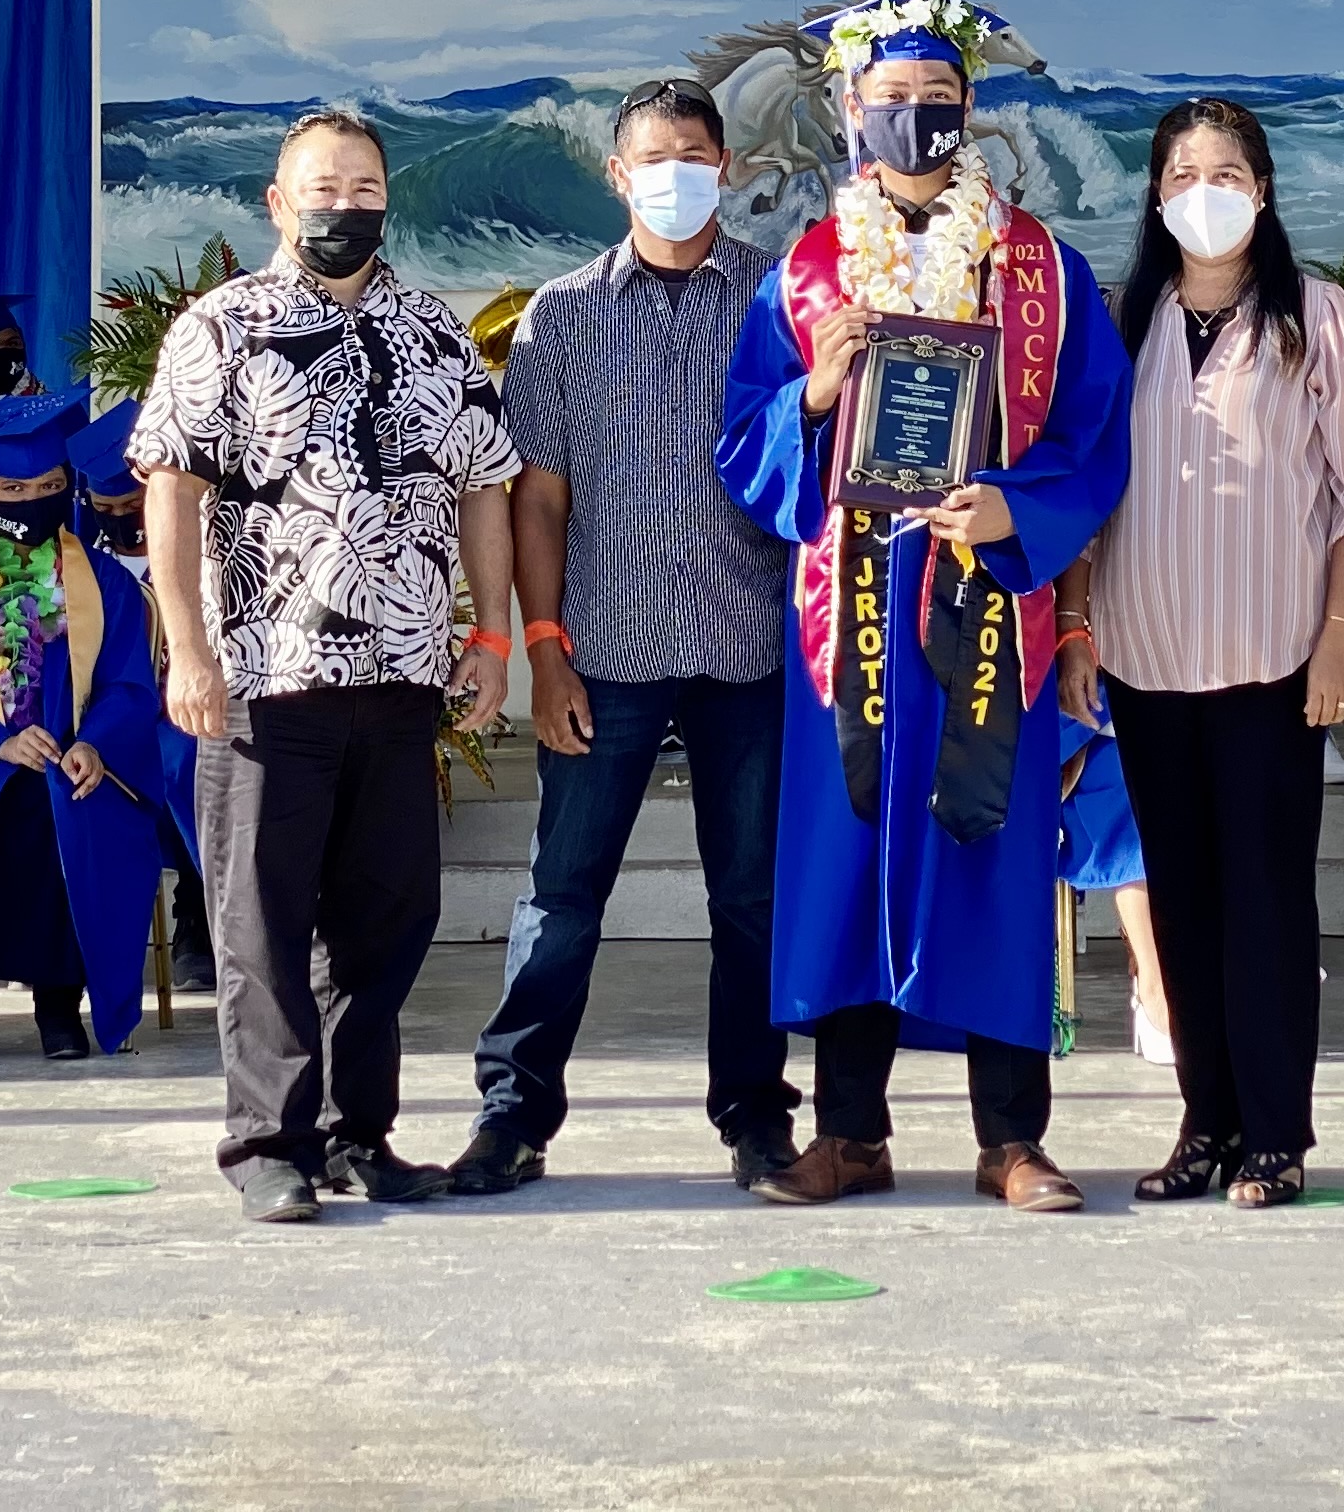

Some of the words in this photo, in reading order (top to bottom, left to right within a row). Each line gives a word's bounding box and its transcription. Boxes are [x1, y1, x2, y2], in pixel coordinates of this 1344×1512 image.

[938, 133, 960, 156] 2021
[1013, 266, 1047, 398] MOCK
[854, 557, 885, 725] JROTC
[970, 592, 1005, 726] 2021
